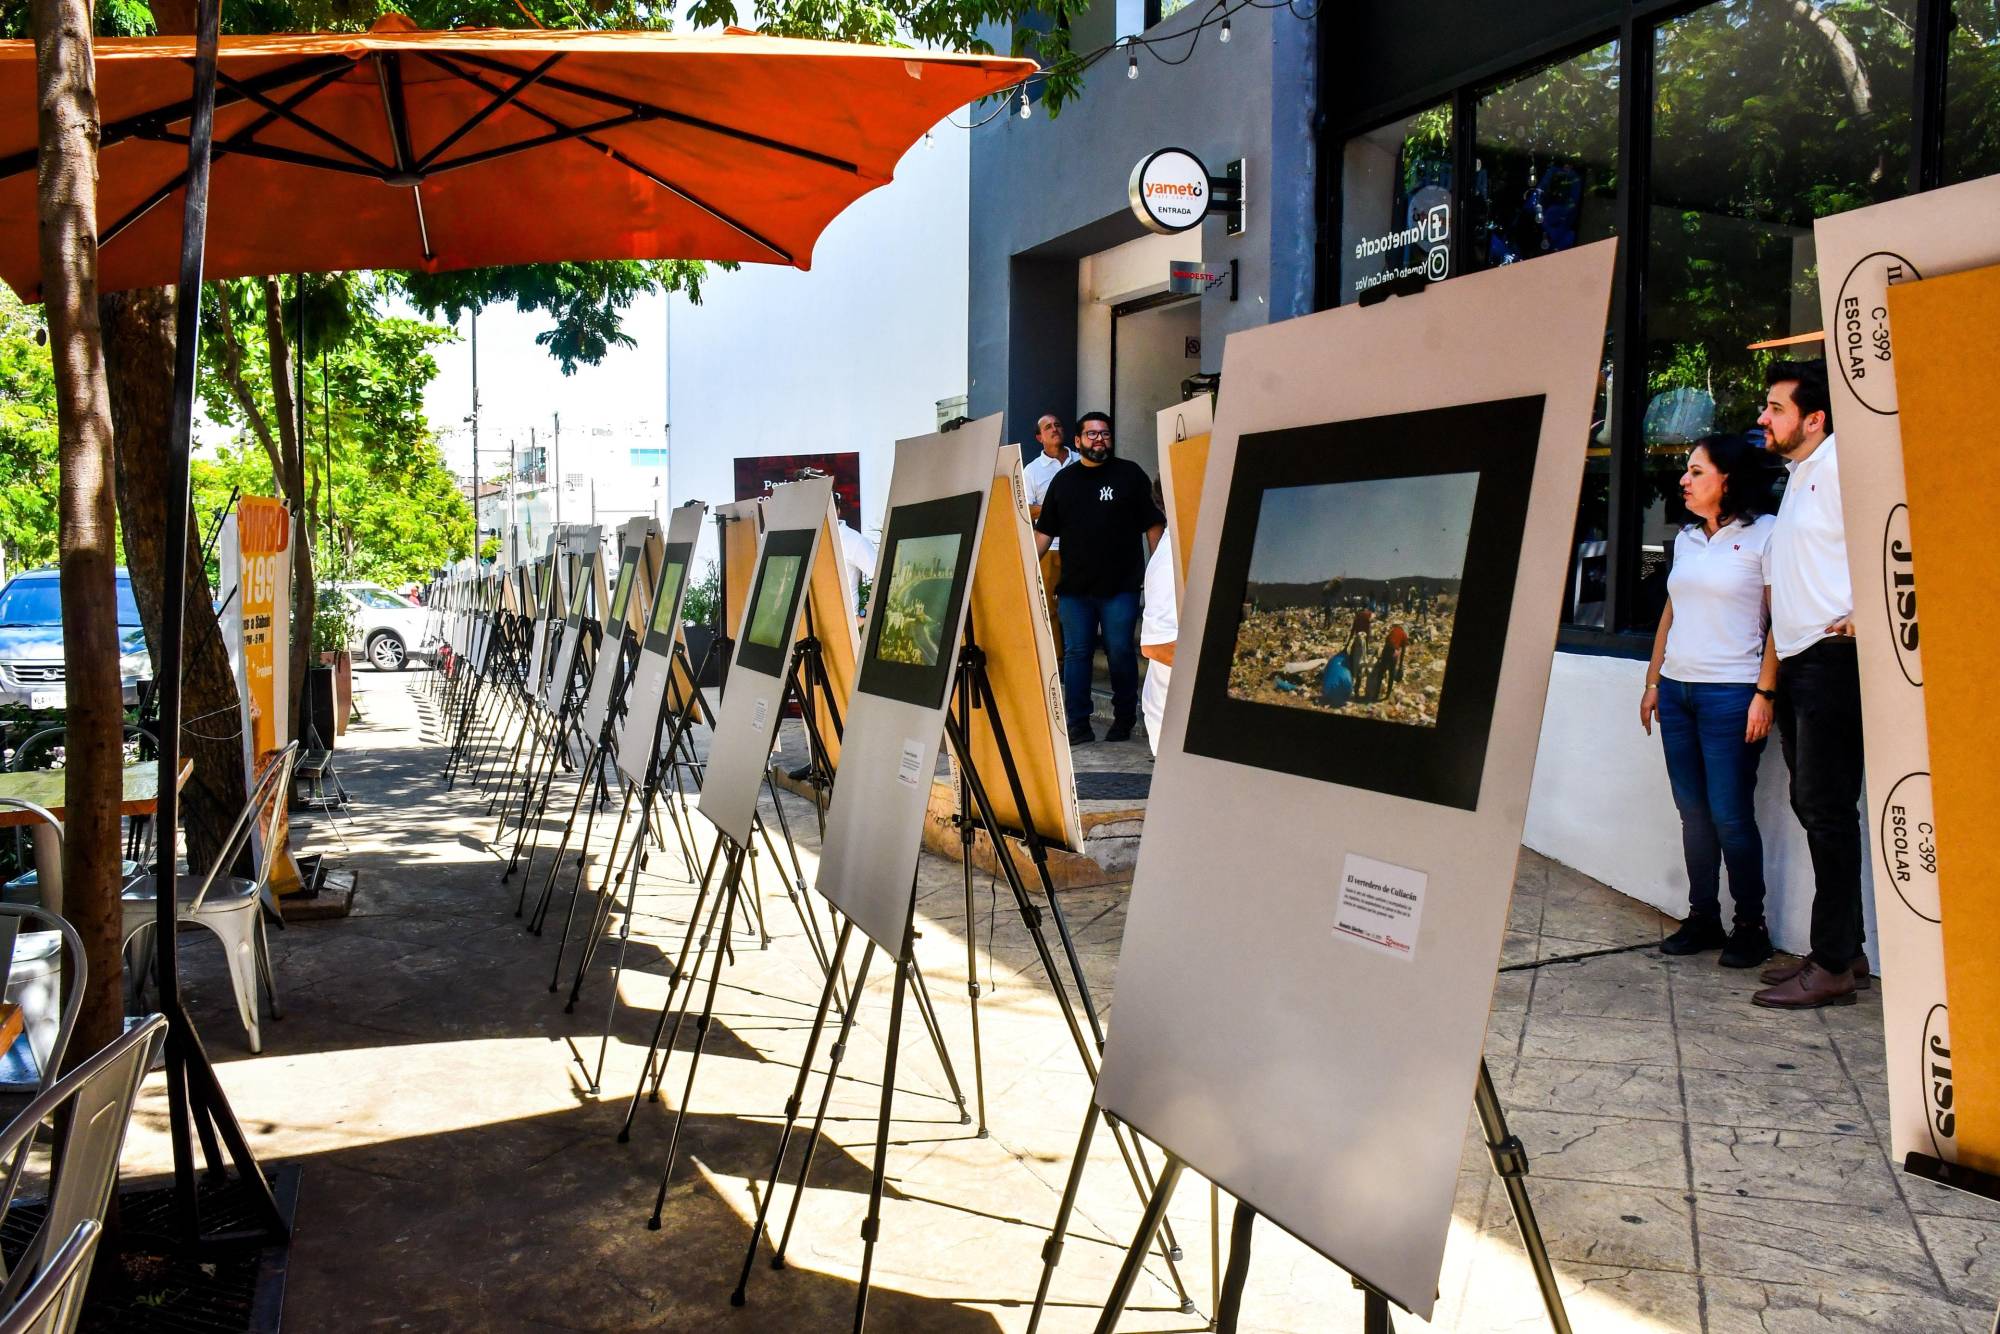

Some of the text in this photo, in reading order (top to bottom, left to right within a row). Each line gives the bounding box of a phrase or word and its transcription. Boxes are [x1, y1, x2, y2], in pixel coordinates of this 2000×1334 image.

[1158, 206, 1192, 215] ENTRADA
[1844, 296, 1865, 380] ESCOLAR
[1015, 474, 1024, 510] ESCOLAR
[1051, 687, 1060, 721] ESCOLAR
[1891, 805, 1911, 882] ESCOLAR
[1347, 874, 1416, 901] El vertedero de Culiacán
